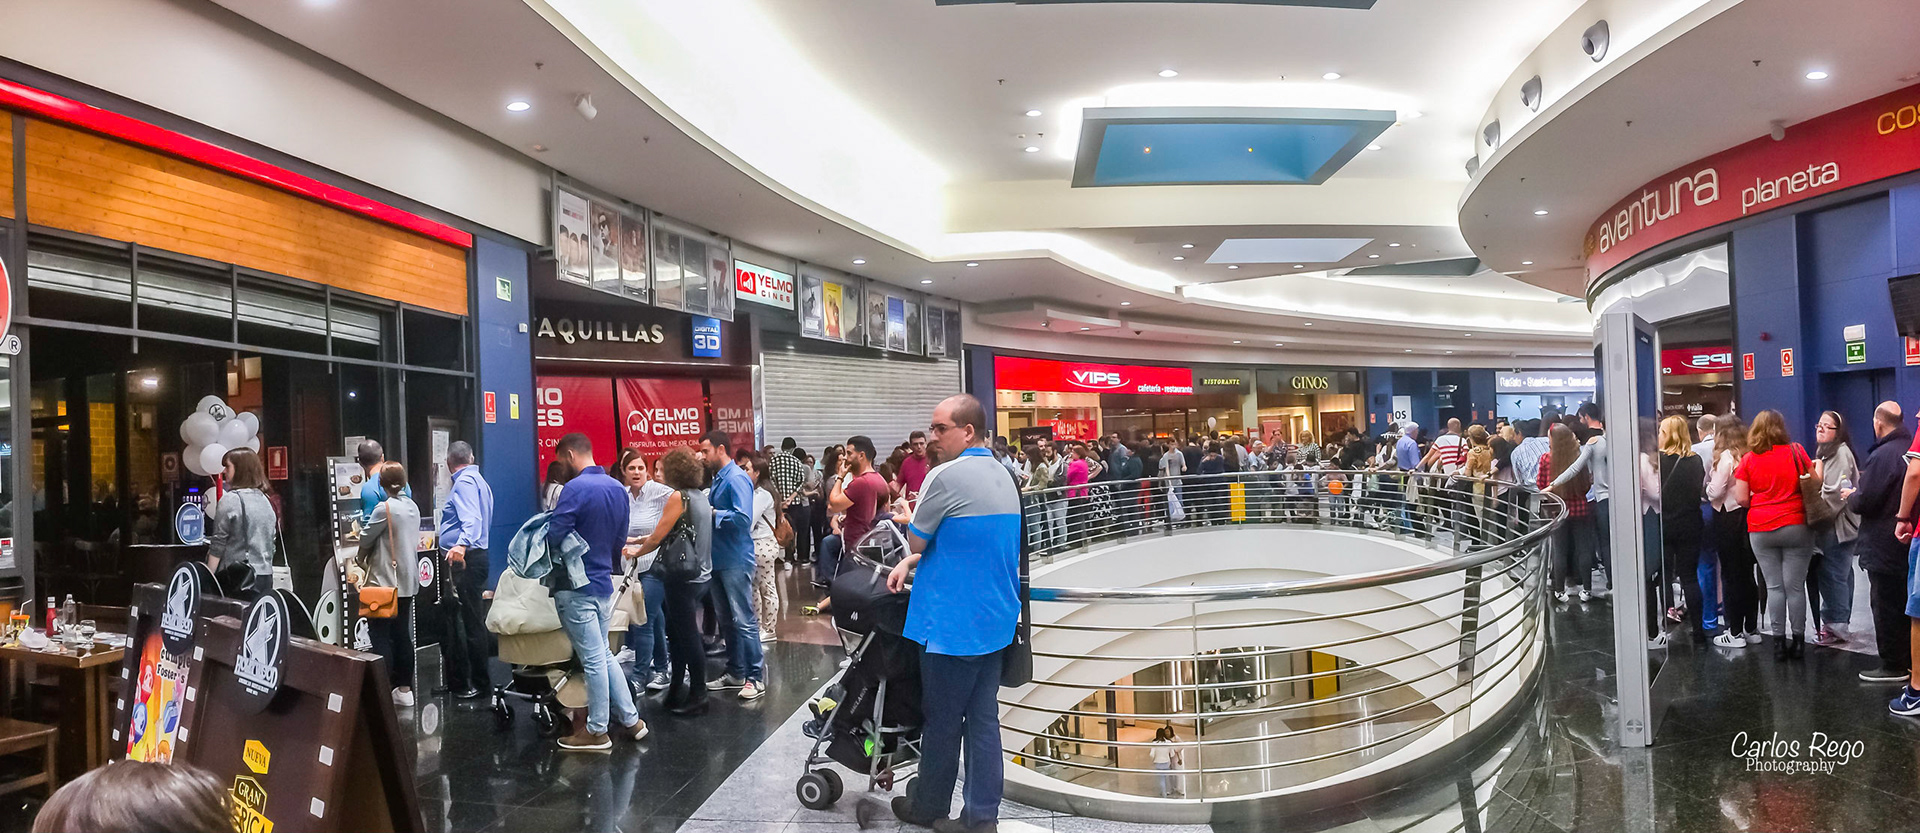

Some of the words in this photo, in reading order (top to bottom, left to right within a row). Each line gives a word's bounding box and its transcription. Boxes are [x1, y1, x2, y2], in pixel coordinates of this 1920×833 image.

[1877, 103, 1920, 135] co
[1599, 167, 1720, 254] aventura
[1742, 161, 1840, 214] planeta
[757, 273, 793, 293] YELMO
[761, 290, 791, 303] CINES
[537, 317, 665, 344] AQUILLAS
[694, 334, 720, 350] 3D
[1072, 370, 1121, 385] VIPS
[1203, 378, 1240, 386] RISTORANTE
[1291, 375, 1329, 390] GINOS
[1164, 385, 1193, 394] restaurante
[643, 407, 699, 421] YELMO
[652, 421, 701, 436] CINES
[657, 440, 669, 448] DEL
[669, 440, 687, 448] MEJOR
[245, 746, 267, 769] NUEVA
[238, 781, 262, 808] GRAN
